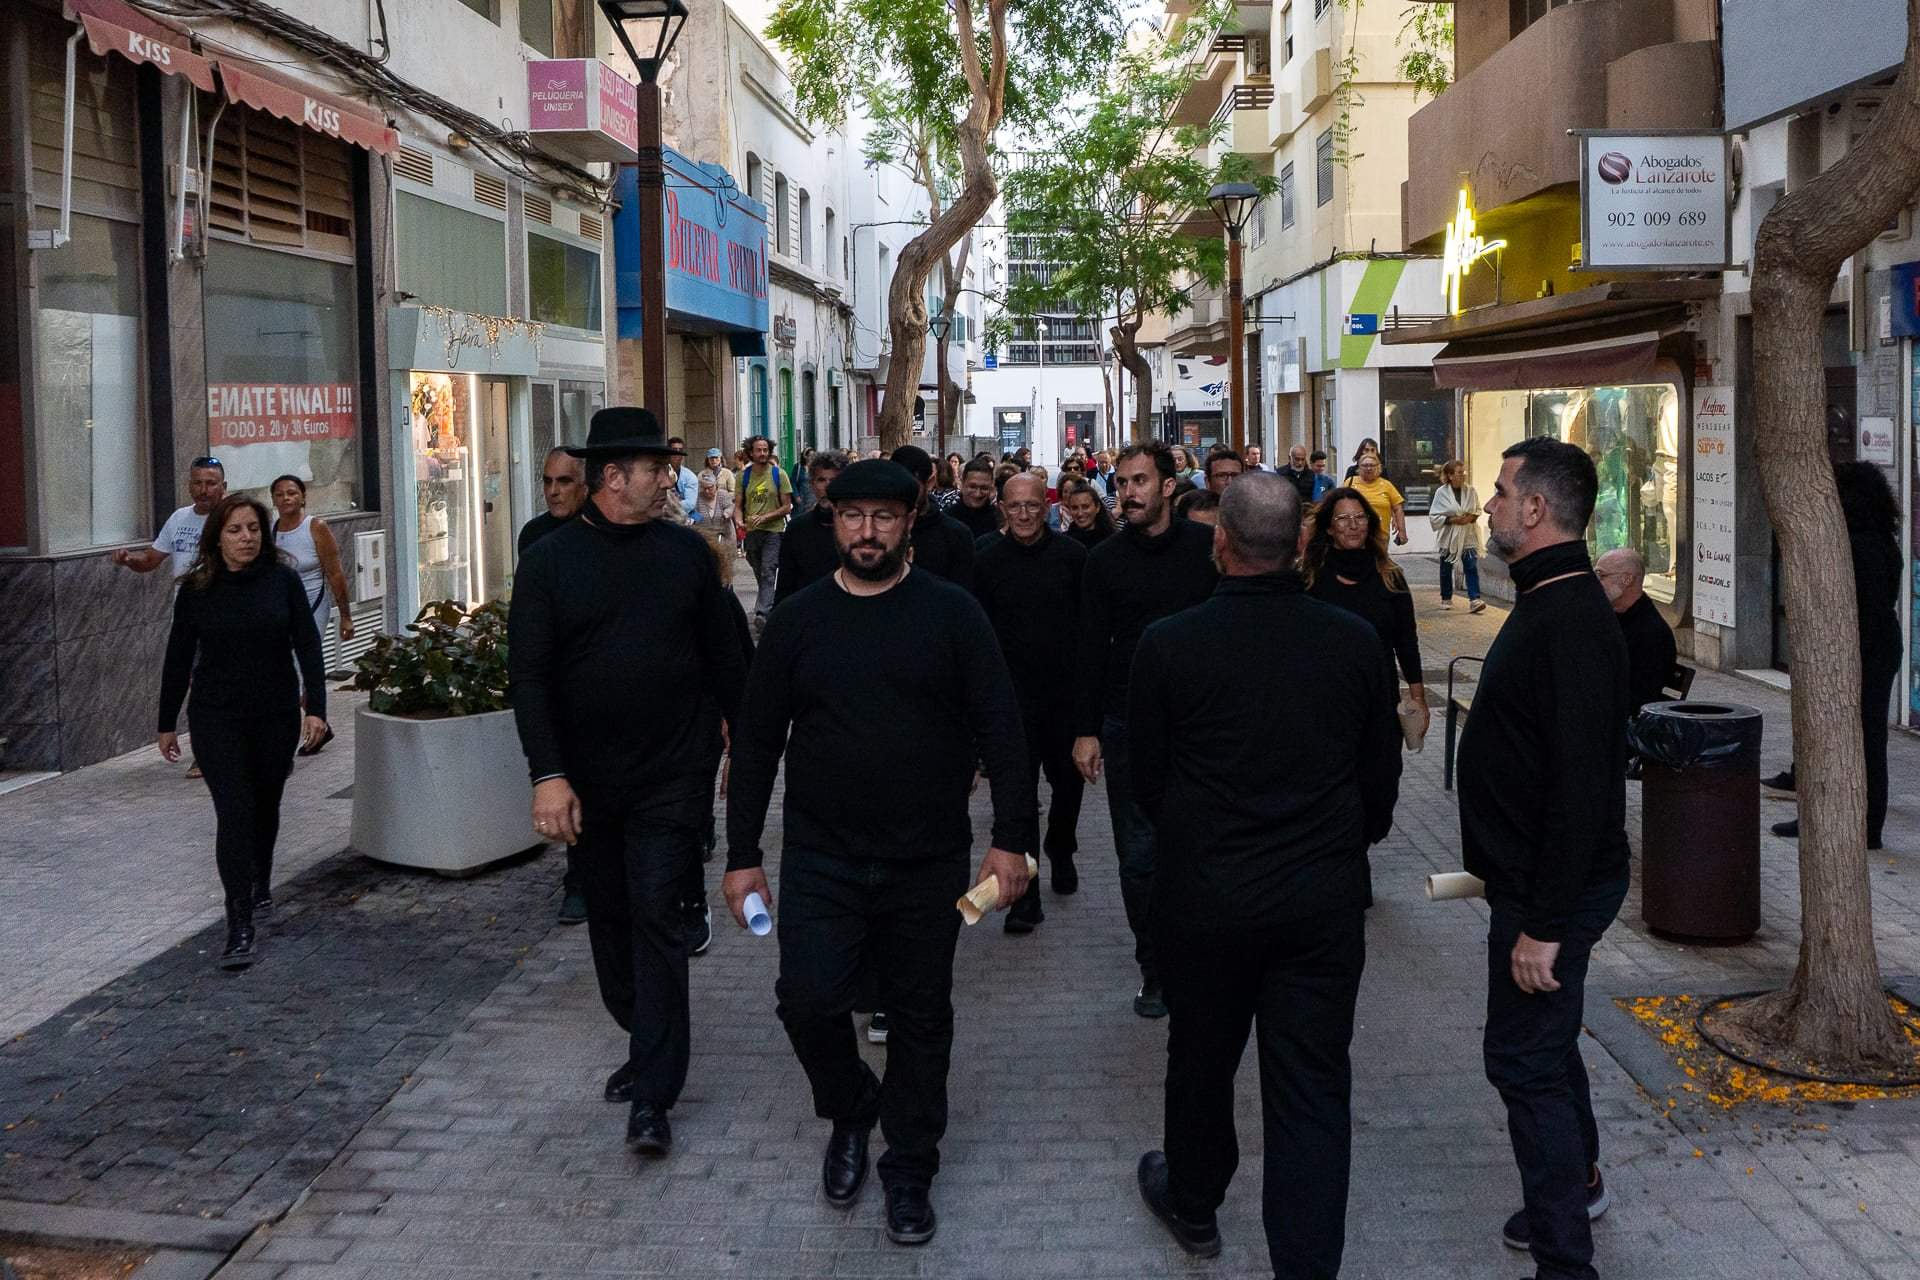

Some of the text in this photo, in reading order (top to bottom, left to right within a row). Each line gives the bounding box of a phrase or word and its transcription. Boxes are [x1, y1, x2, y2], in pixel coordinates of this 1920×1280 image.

[543, 102, 575, 112] UNISEX
[1640, 153, 1702, 171] Abogados
[1636, 168, 1716, 184] Lanzarote
[1607, 210, 1707, 227] 902 009 689
[208, 386, 353, 417] EMATE FINAL !!!
[221, 421, 256, 438] TODO
[258, 424, 265, 437] a
[270, 419, 281, 437] 20
[281, 422, 290, 440] y
[291, 419, 301, 435] 30
[1696, 472, 1721, 483] LACOSE
